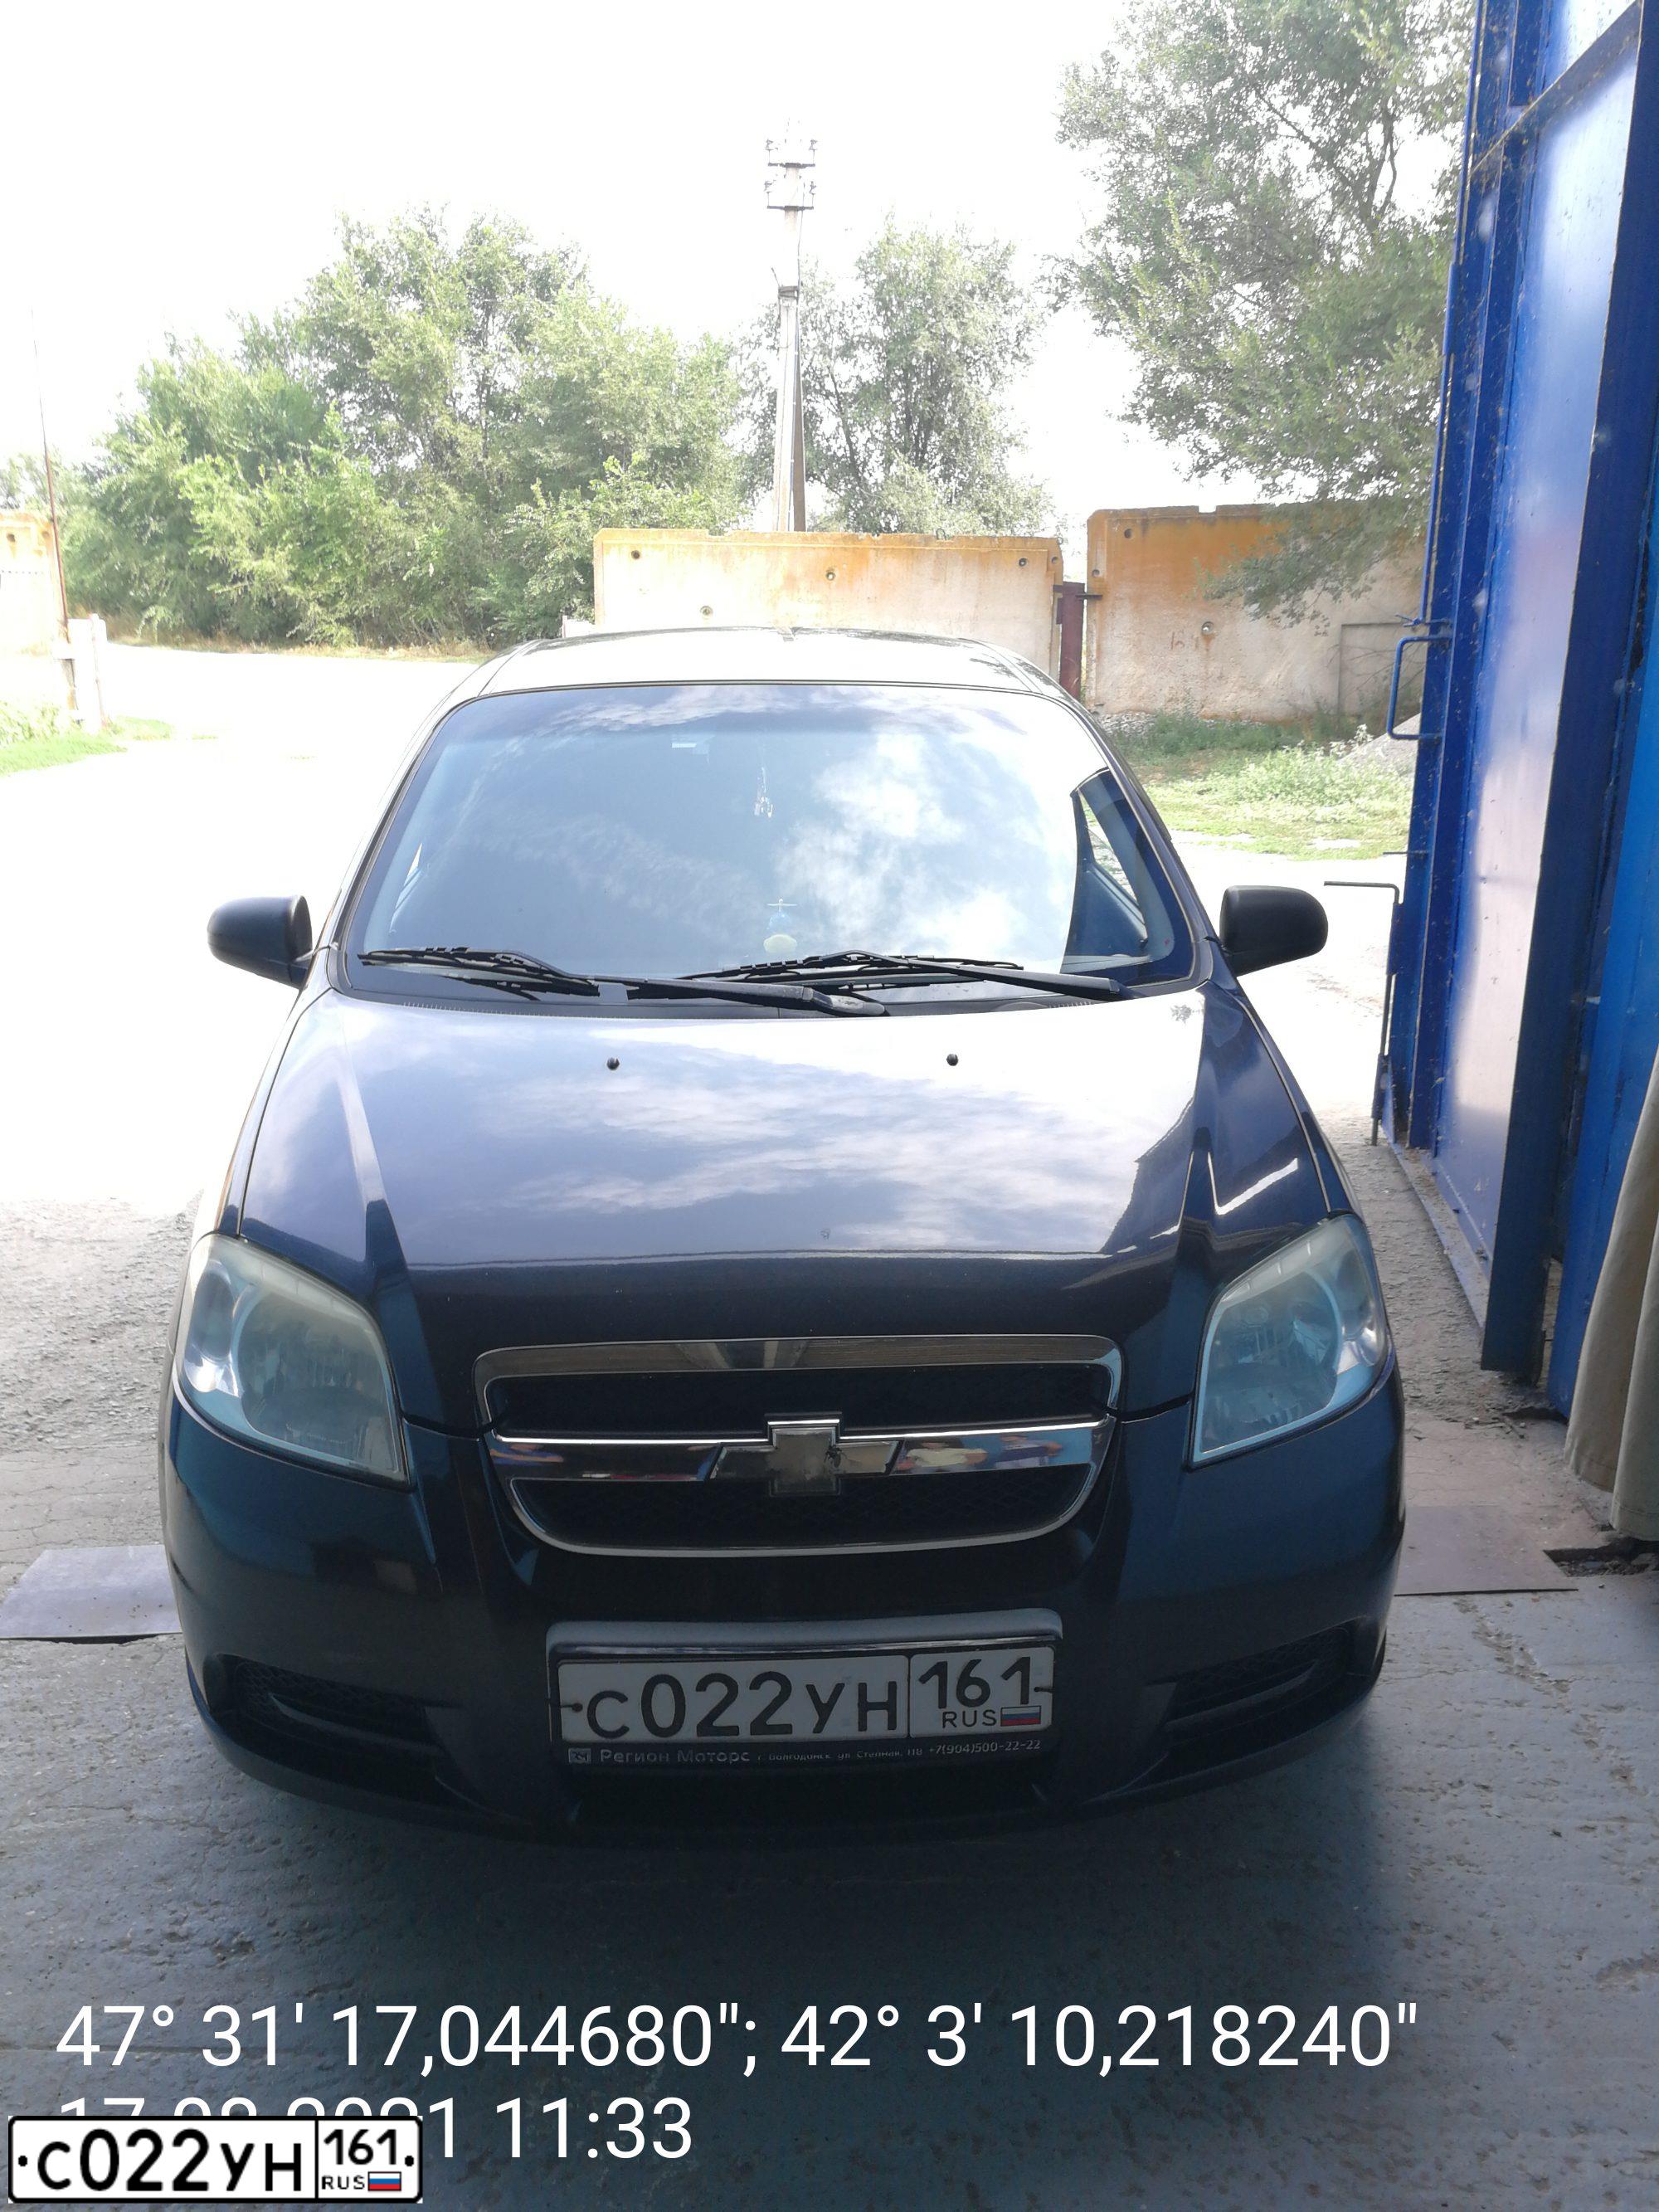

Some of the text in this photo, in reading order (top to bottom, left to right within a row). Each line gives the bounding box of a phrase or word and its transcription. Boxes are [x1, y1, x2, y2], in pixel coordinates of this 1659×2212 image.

[918, 1656, 1031, 1709] 161
[941, 1710, 997, 1729] RUS
[600, 1748, 669, 1763] Регион
[676, 1749, 750, 1765] Моторс
